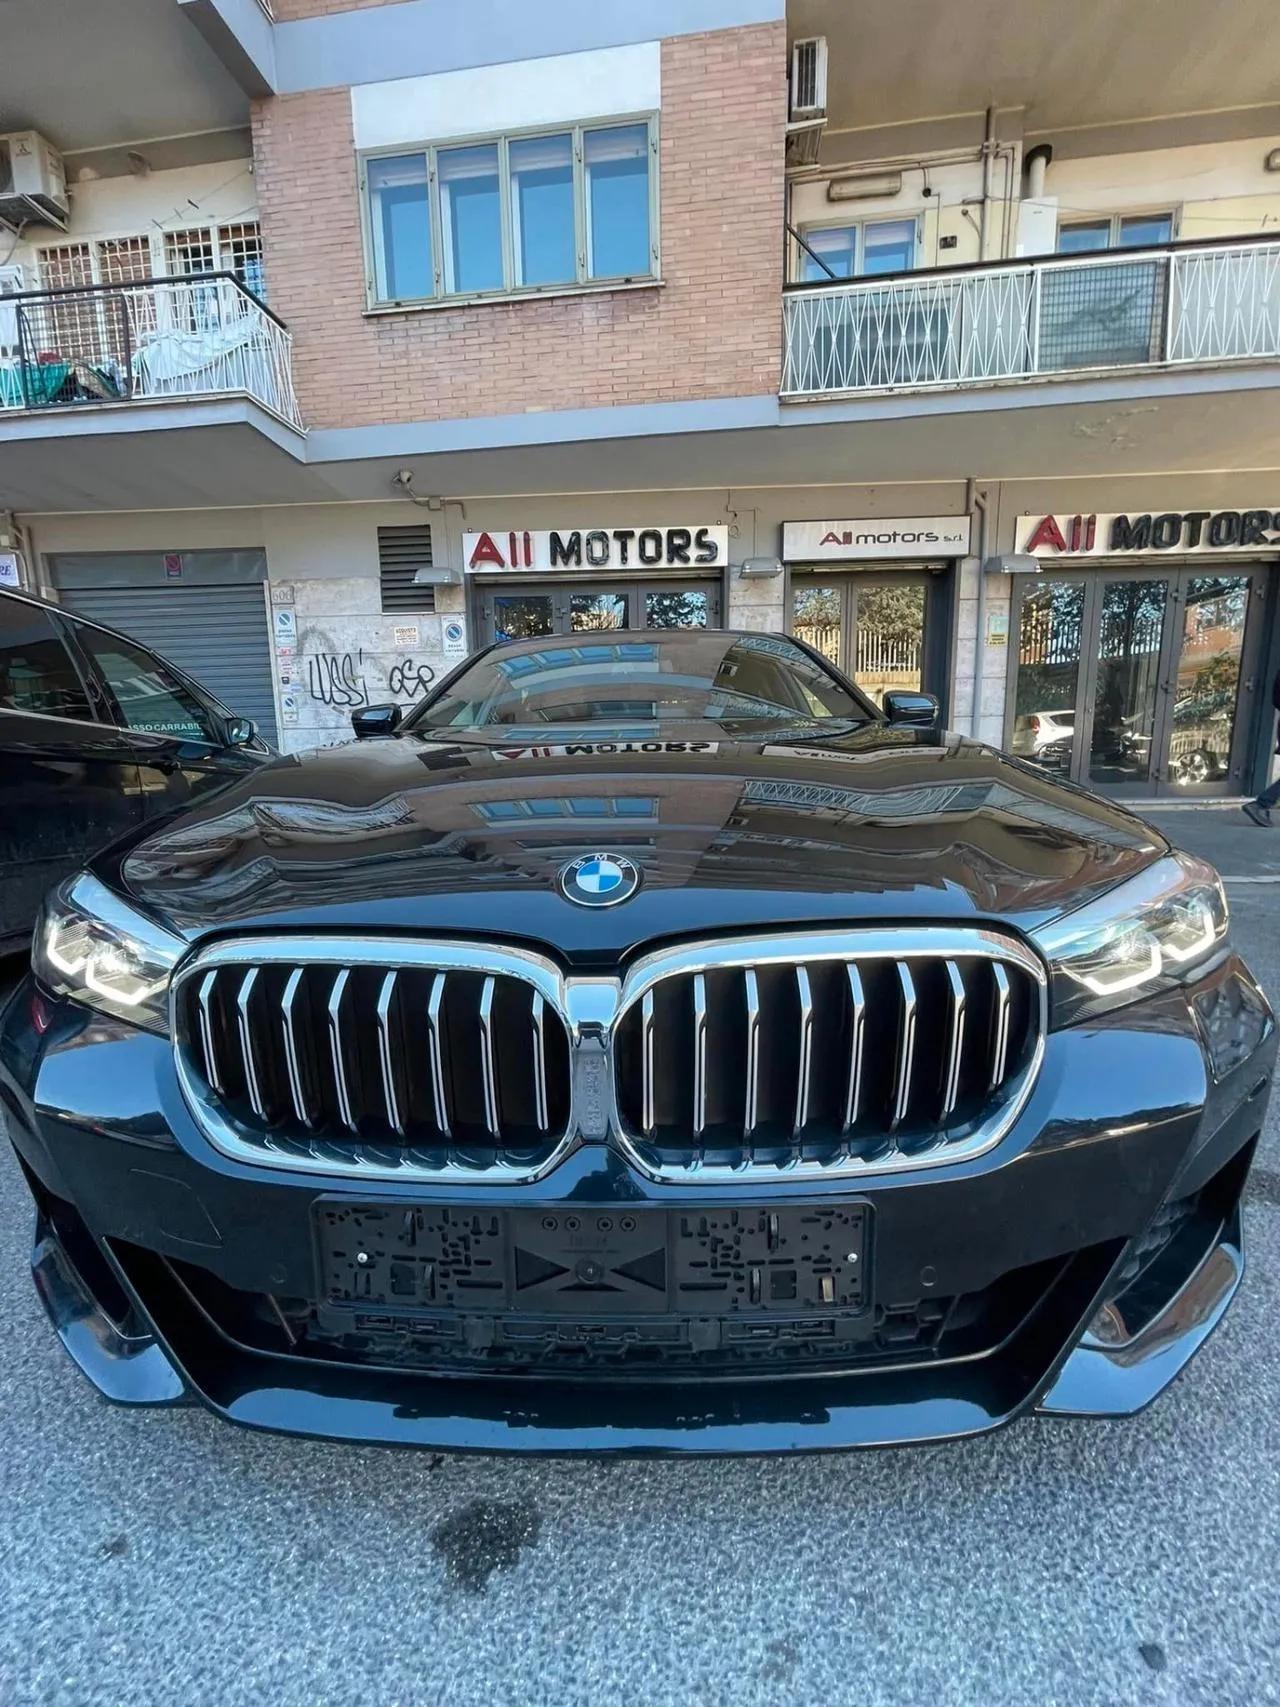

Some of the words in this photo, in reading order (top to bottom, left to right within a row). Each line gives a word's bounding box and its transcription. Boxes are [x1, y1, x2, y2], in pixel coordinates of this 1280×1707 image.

[856, 531, 939, 545] motors
[1027, 514, 1097, 552] All
[1111, 510, 1280, 550] MOTOR
[469, 531, 533, 568] All
[550, 528, 719, 567] MOTORS
[153, 722, 202, 731] CARRABIL
[572, 853, 630, 869] BMW
